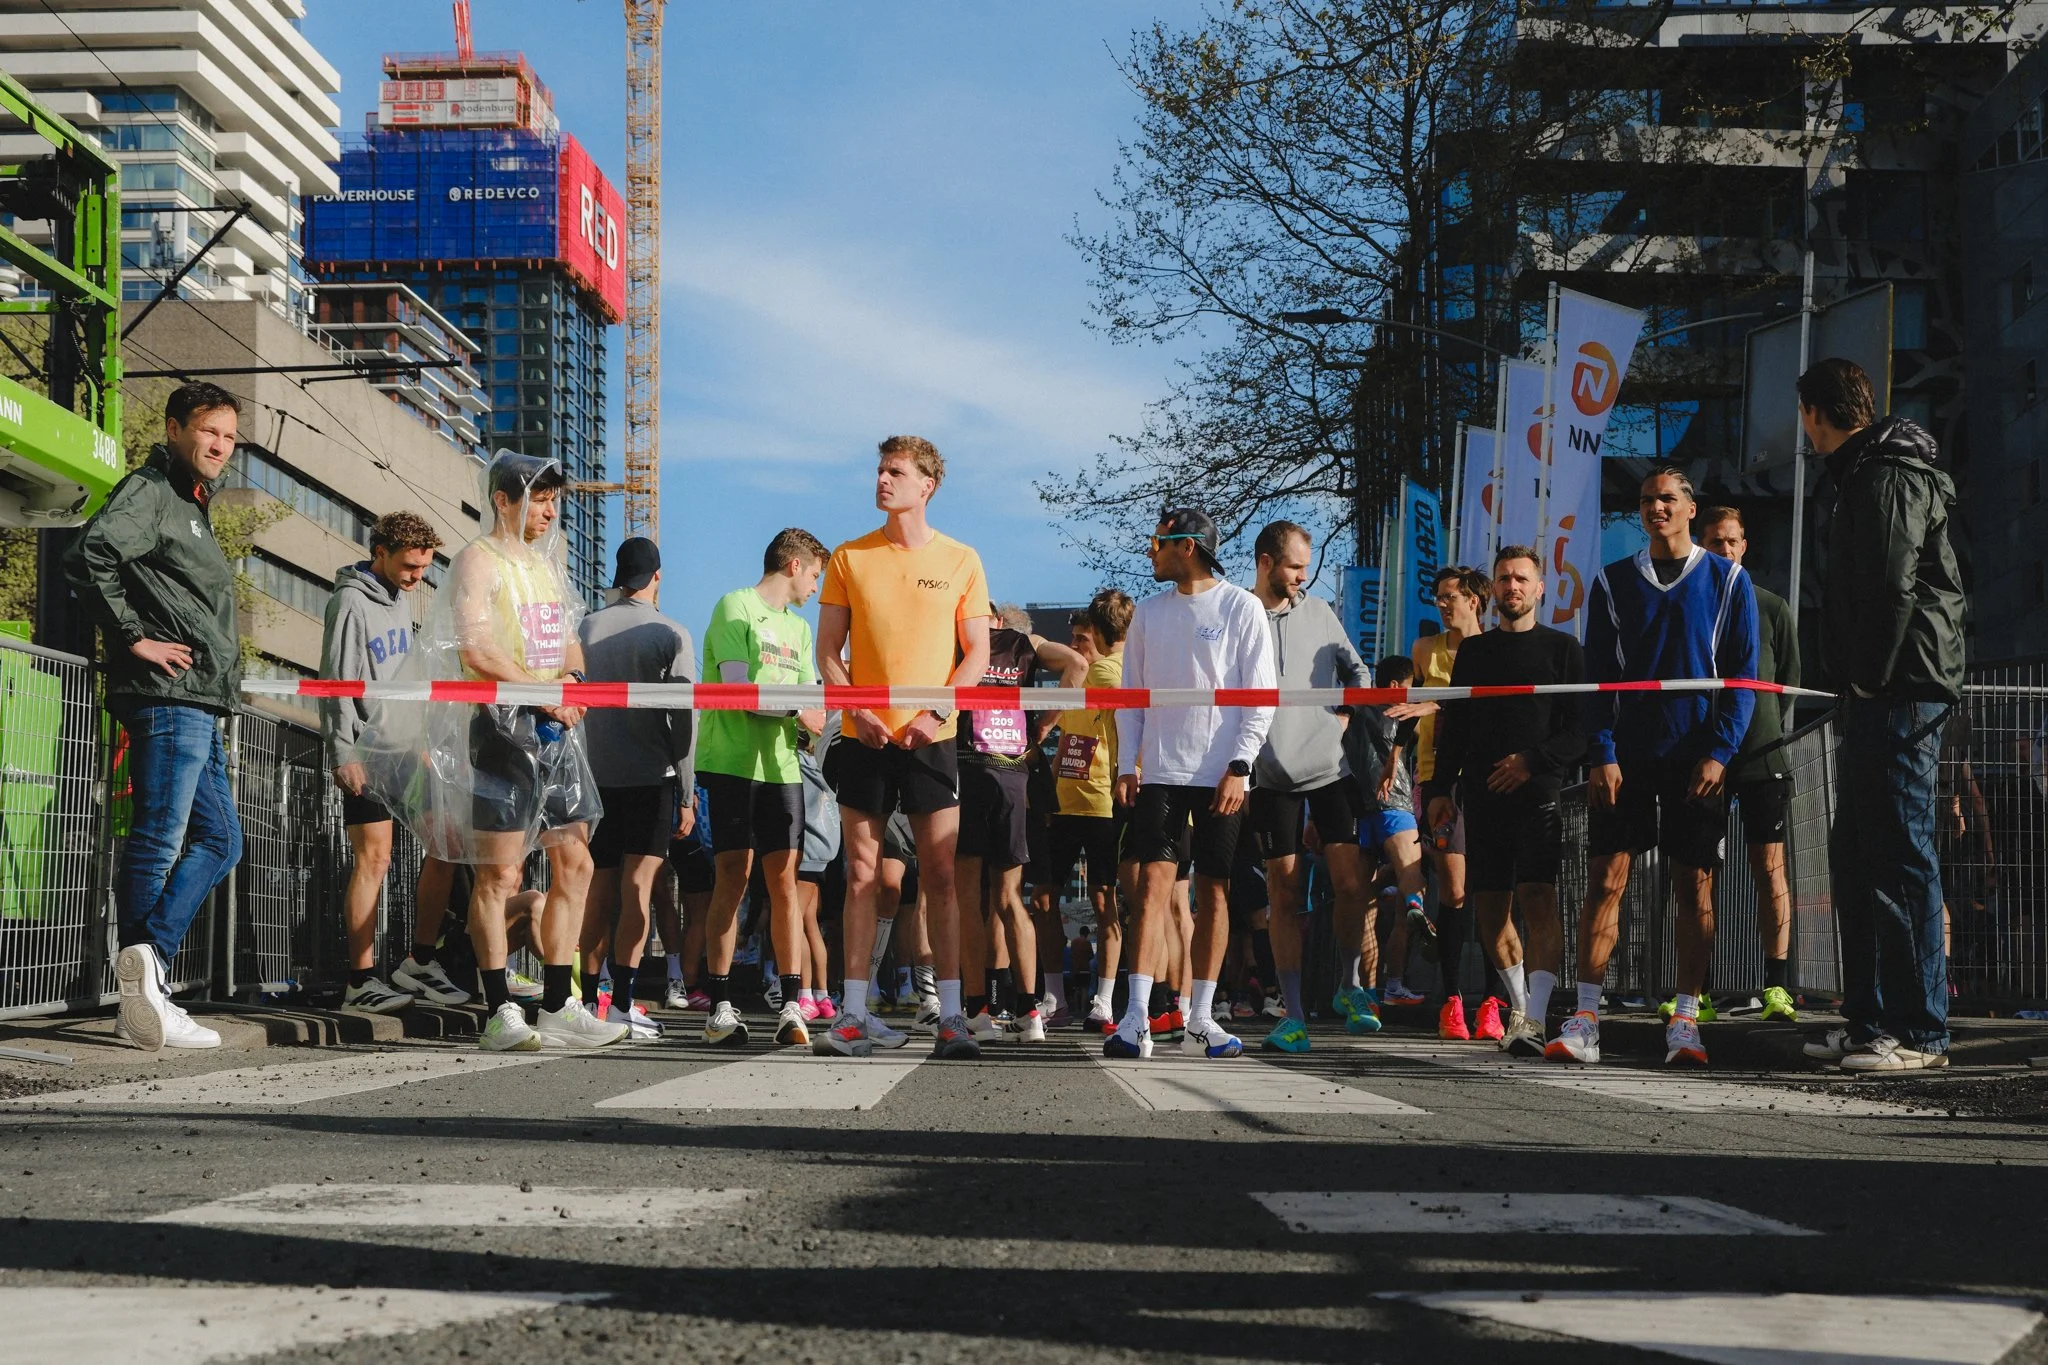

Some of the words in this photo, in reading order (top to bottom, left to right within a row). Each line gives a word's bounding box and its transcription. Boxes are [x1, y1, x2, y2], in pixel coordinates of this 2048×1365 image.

[451, 103, 514, 116] Roodenburg
[464, 187, 539, 200] REDEVCO
[581, 183, 618, 271] RED
[1569, 425, 1602, 455] NN
[92, 429, 117, 469] 3488
[368, 628, 414, 665] BEA
[990, 717, 1014, 727] 1209
[981, 727, 1022, 741] COEN
[1061, 757, 1087, 769] RUURD
